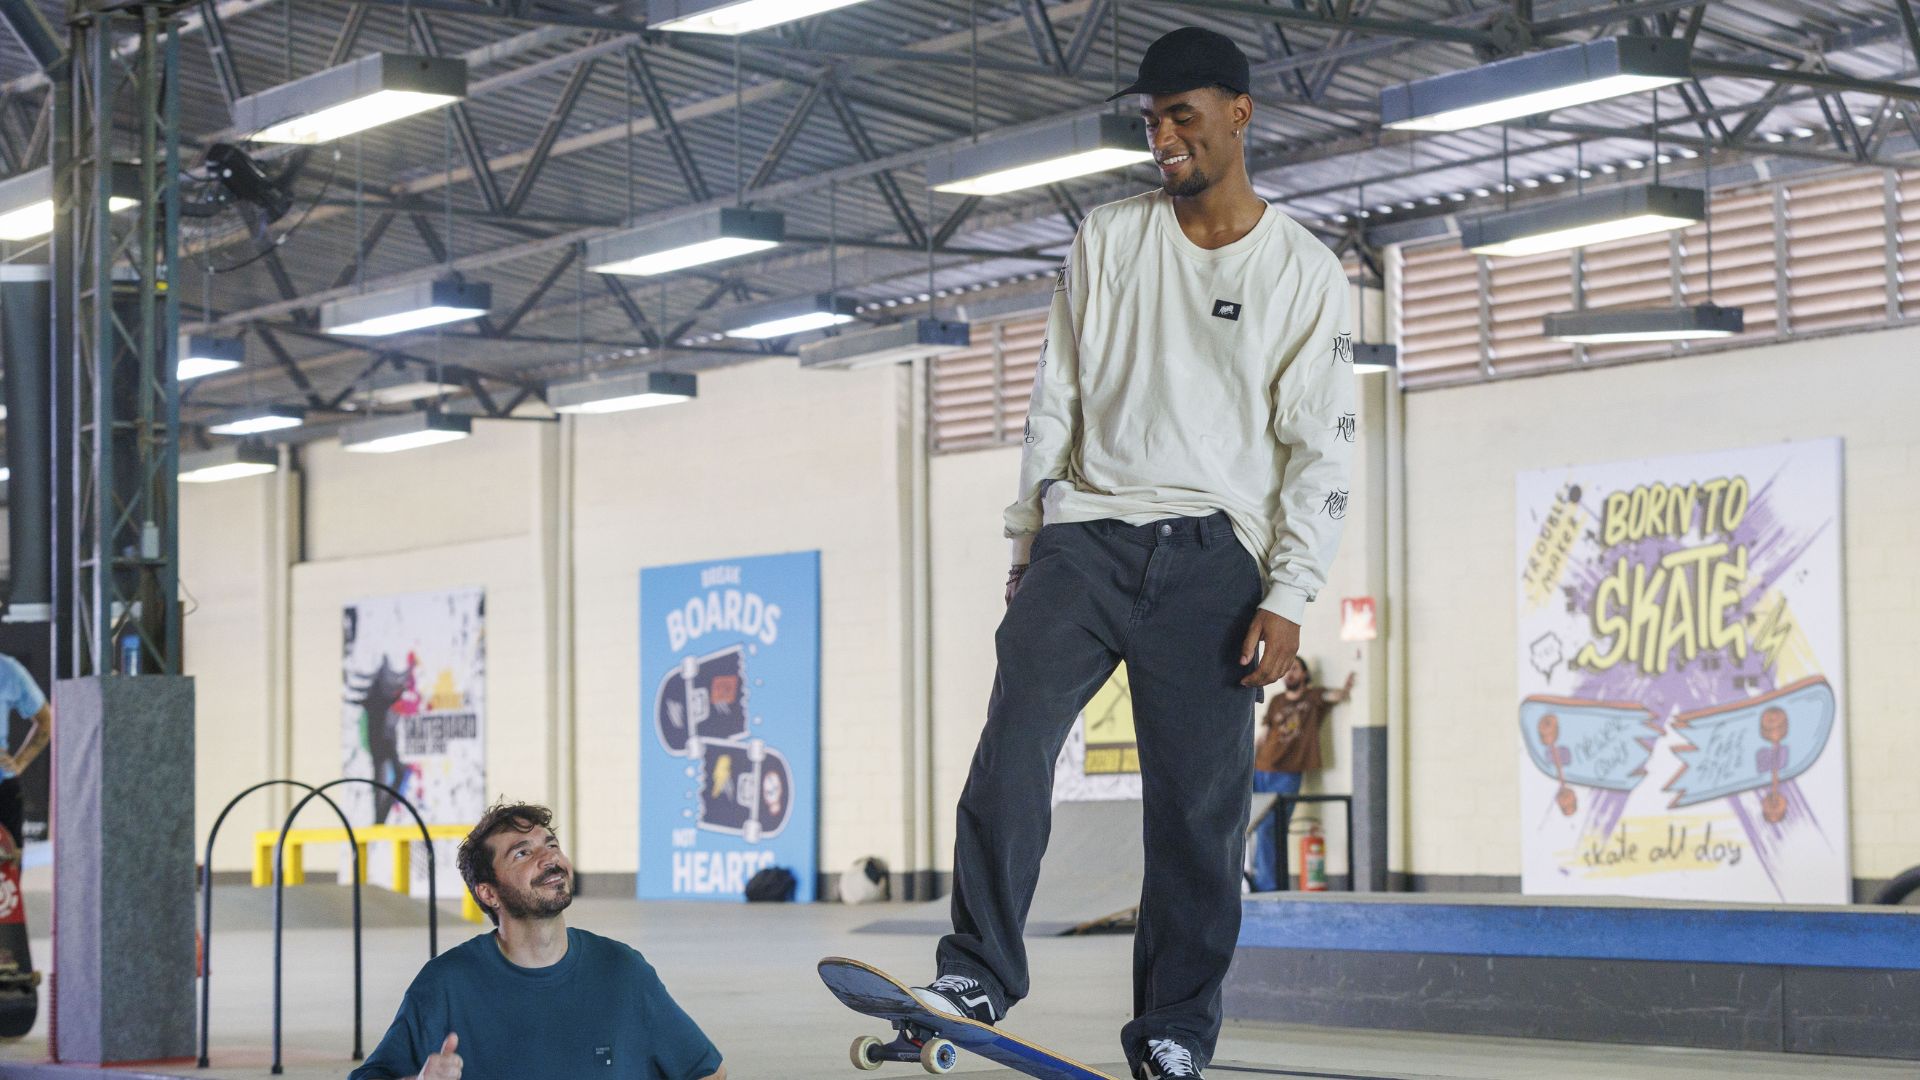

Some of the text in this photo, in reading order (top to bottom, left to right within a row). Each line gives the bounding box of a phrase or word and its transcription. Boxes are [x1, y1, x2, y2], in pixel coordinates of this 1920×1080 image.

[1603, 475, 1749, 545] BORN TO
[666, 590, 781, 652] BOARDS
[1577, 543, 1748, 673] SKATE
[1583, 821, 1742, 866] skate all day
